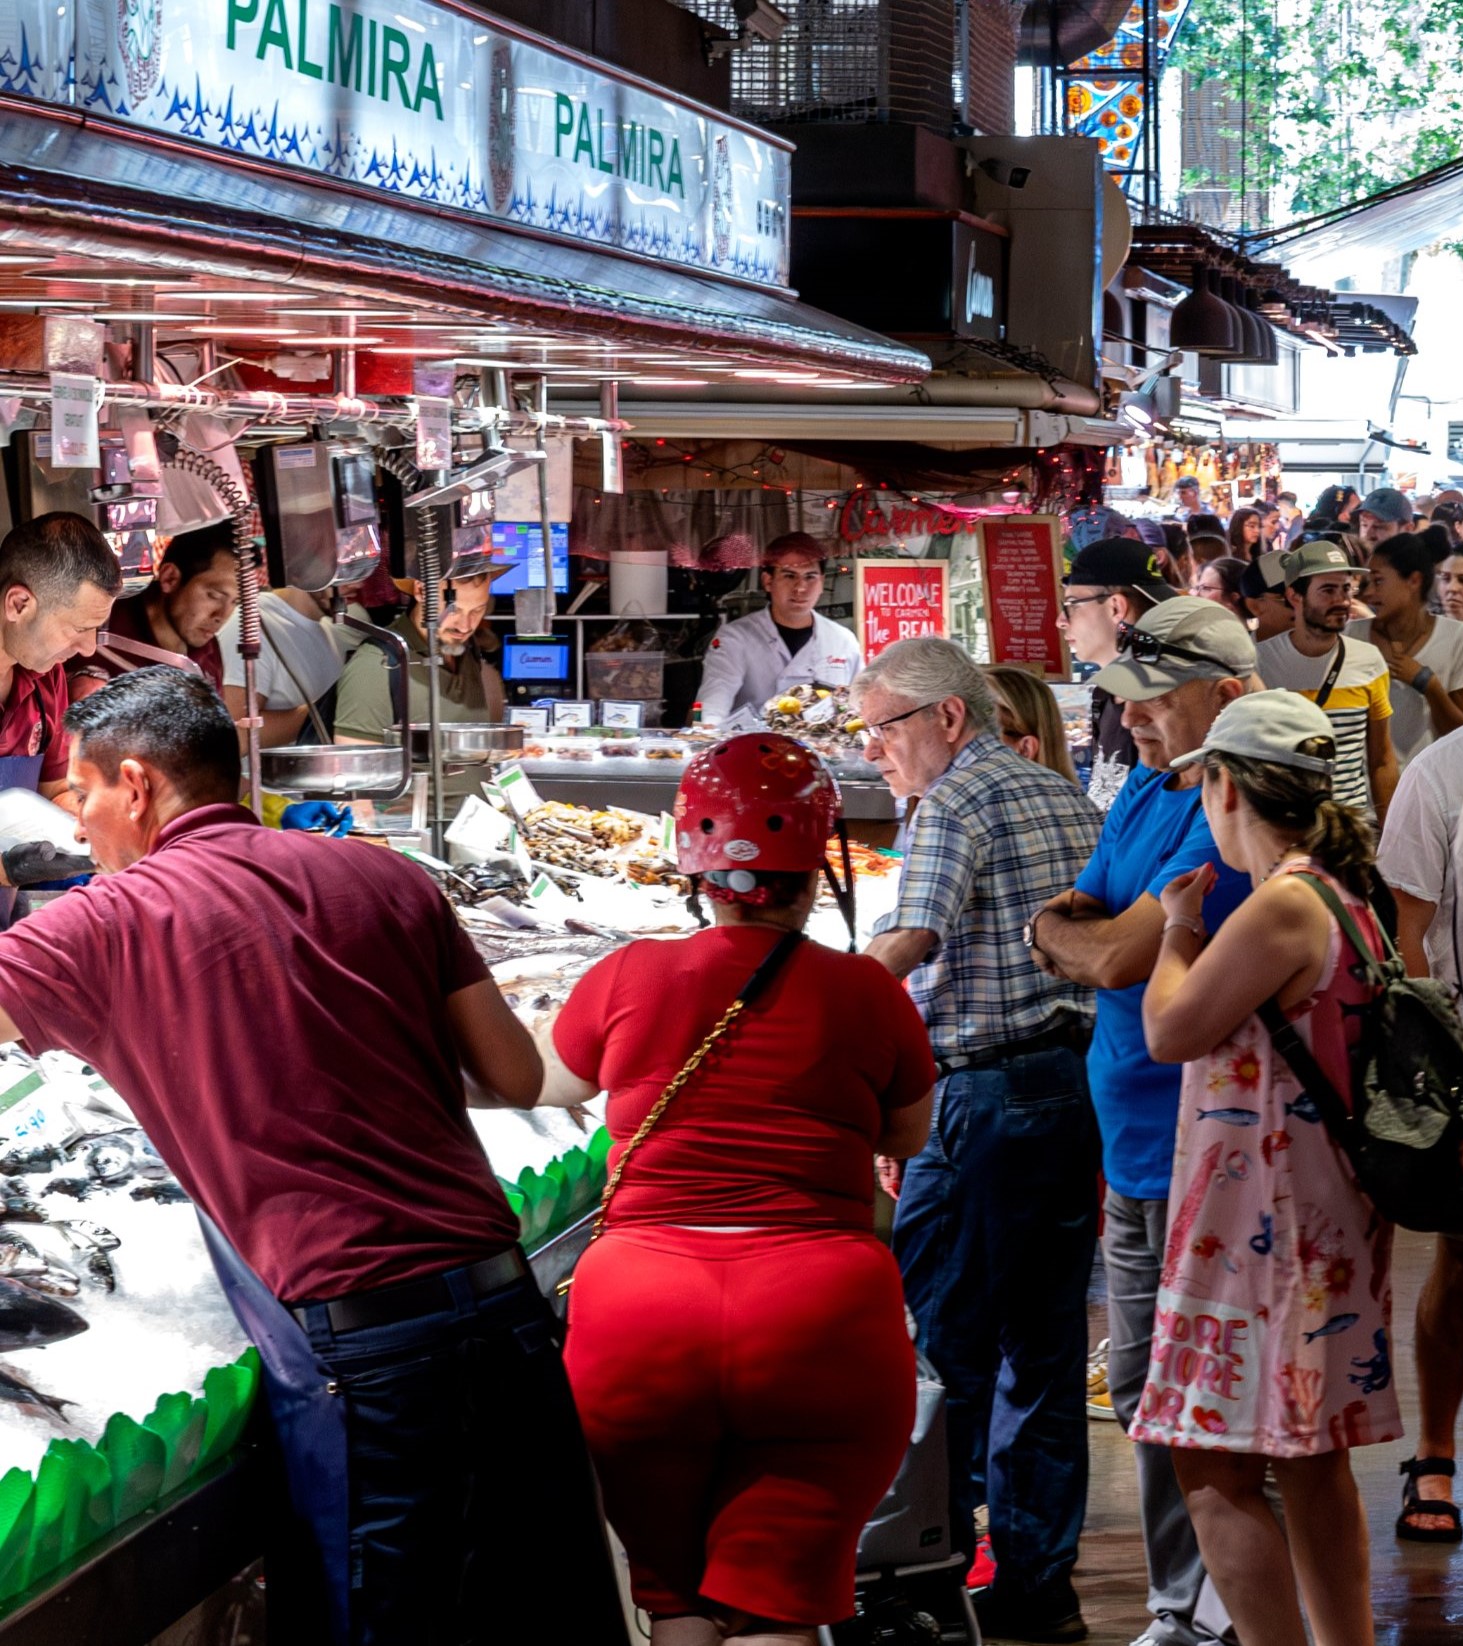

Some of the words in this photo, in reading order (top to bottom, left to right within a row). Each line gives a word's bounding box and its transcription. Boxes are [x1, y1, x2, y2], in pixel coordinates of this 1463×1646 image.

[227, 0, 444, 121] PALMIRA
[555, 91, 685, 199] PALMIRA
[864, 582, 940, 607] WELCOME
[866, 611, 890, 645] the
[899, 620, 935, 640] REAL
